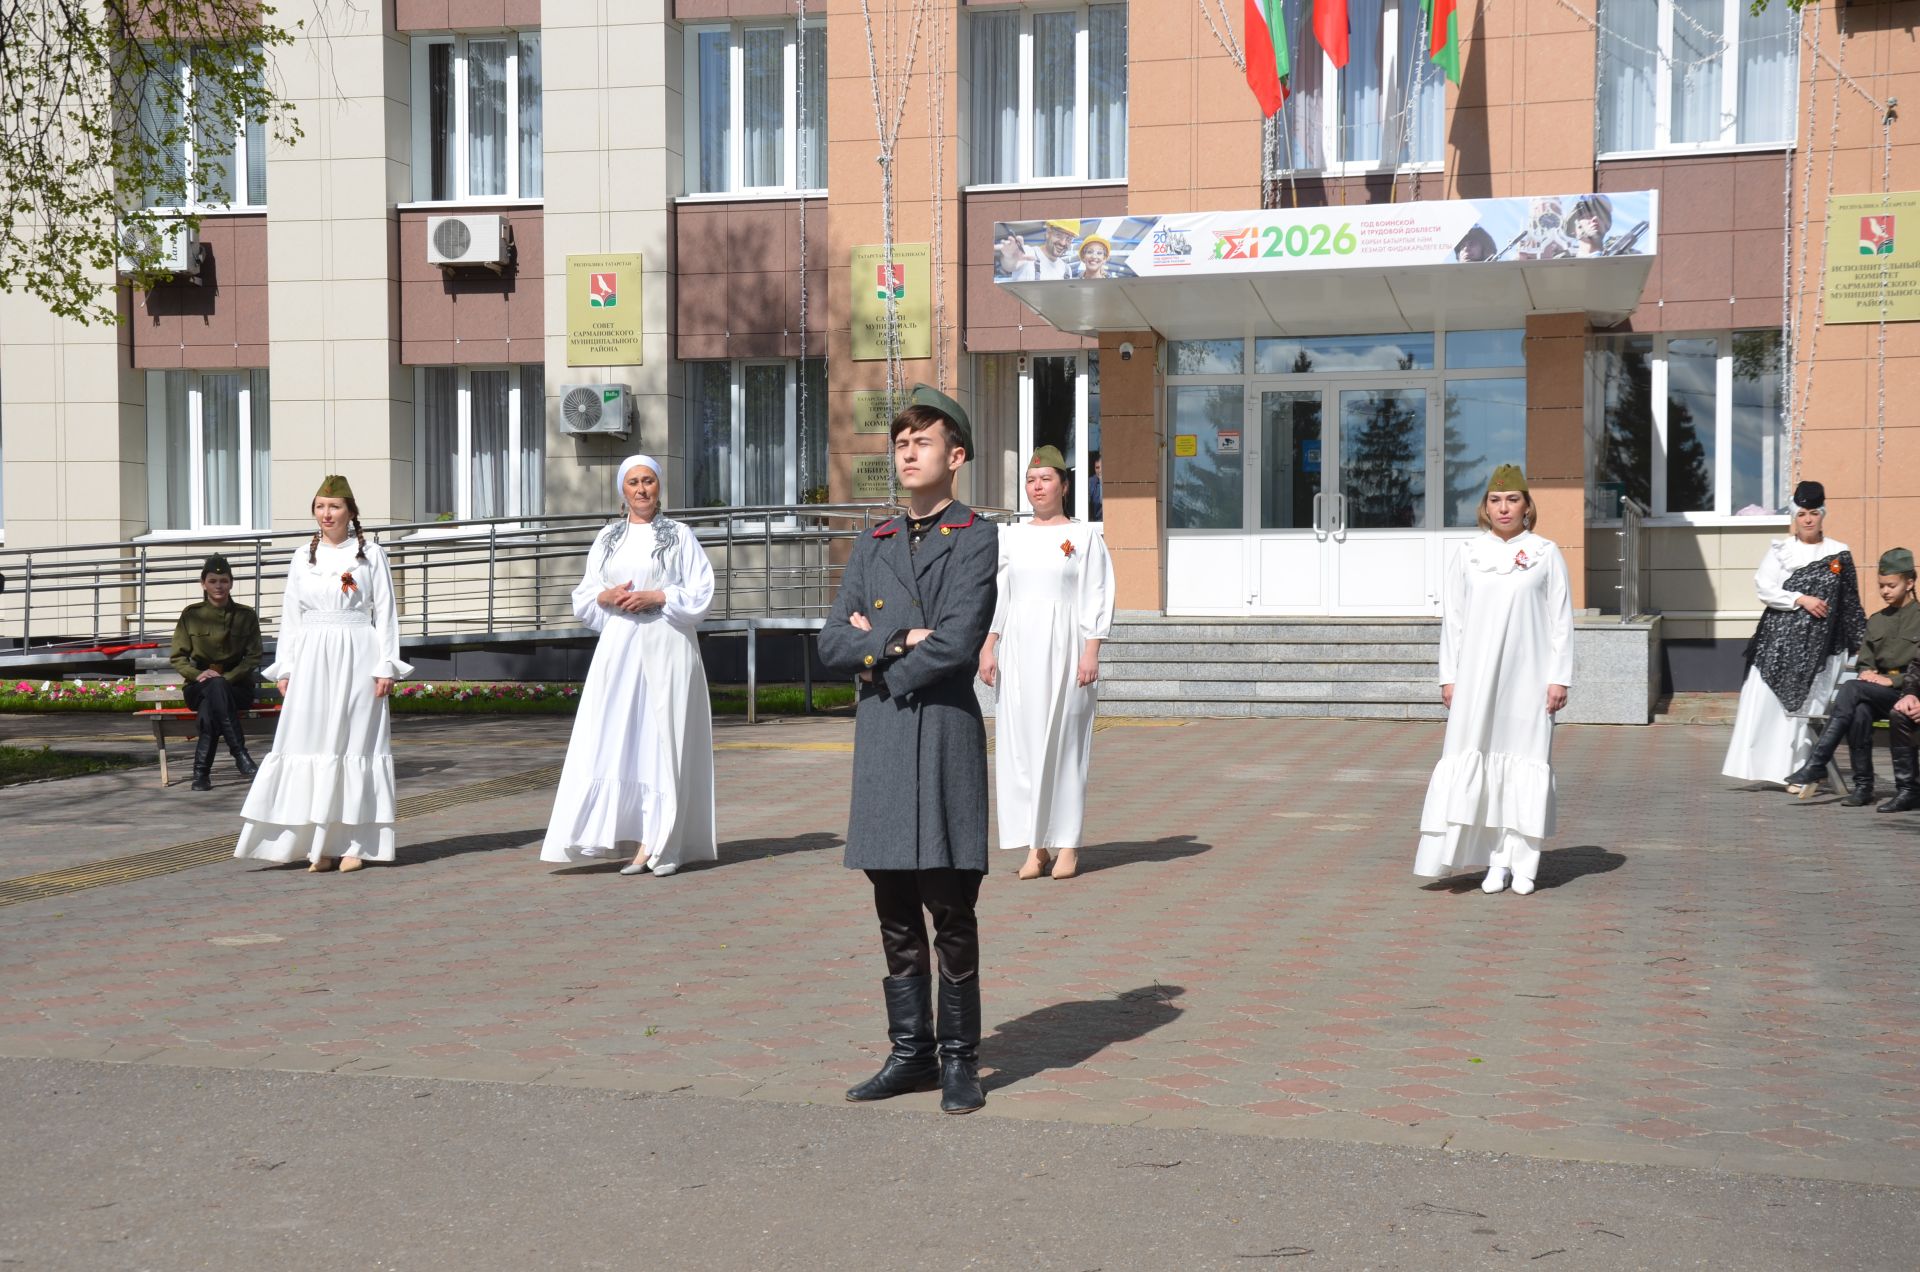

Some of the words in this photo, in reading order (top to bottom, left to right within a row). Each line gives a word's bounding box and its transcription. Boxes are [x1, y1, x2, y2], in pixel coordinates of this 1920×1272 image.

[1376, 218, 1415, 227] ВОИНСКОЙ
[1367, 227, 1404, 236] ТРУДОВОЙ
[1405, 226, 1441, 234] ДОБЛЕСТИ
[1153, 233, 1167, 244] 20
[1262, 222, 1358, 258] 2026
[1153, 243, 1167, 254] 26
[573, 329, 634, 338] САРМАНОВСКОГО
[570, 337, 639, 346] МУНИЦИПАЛЬНОГО
[590, 345, 619, 353] РАЙОНА
